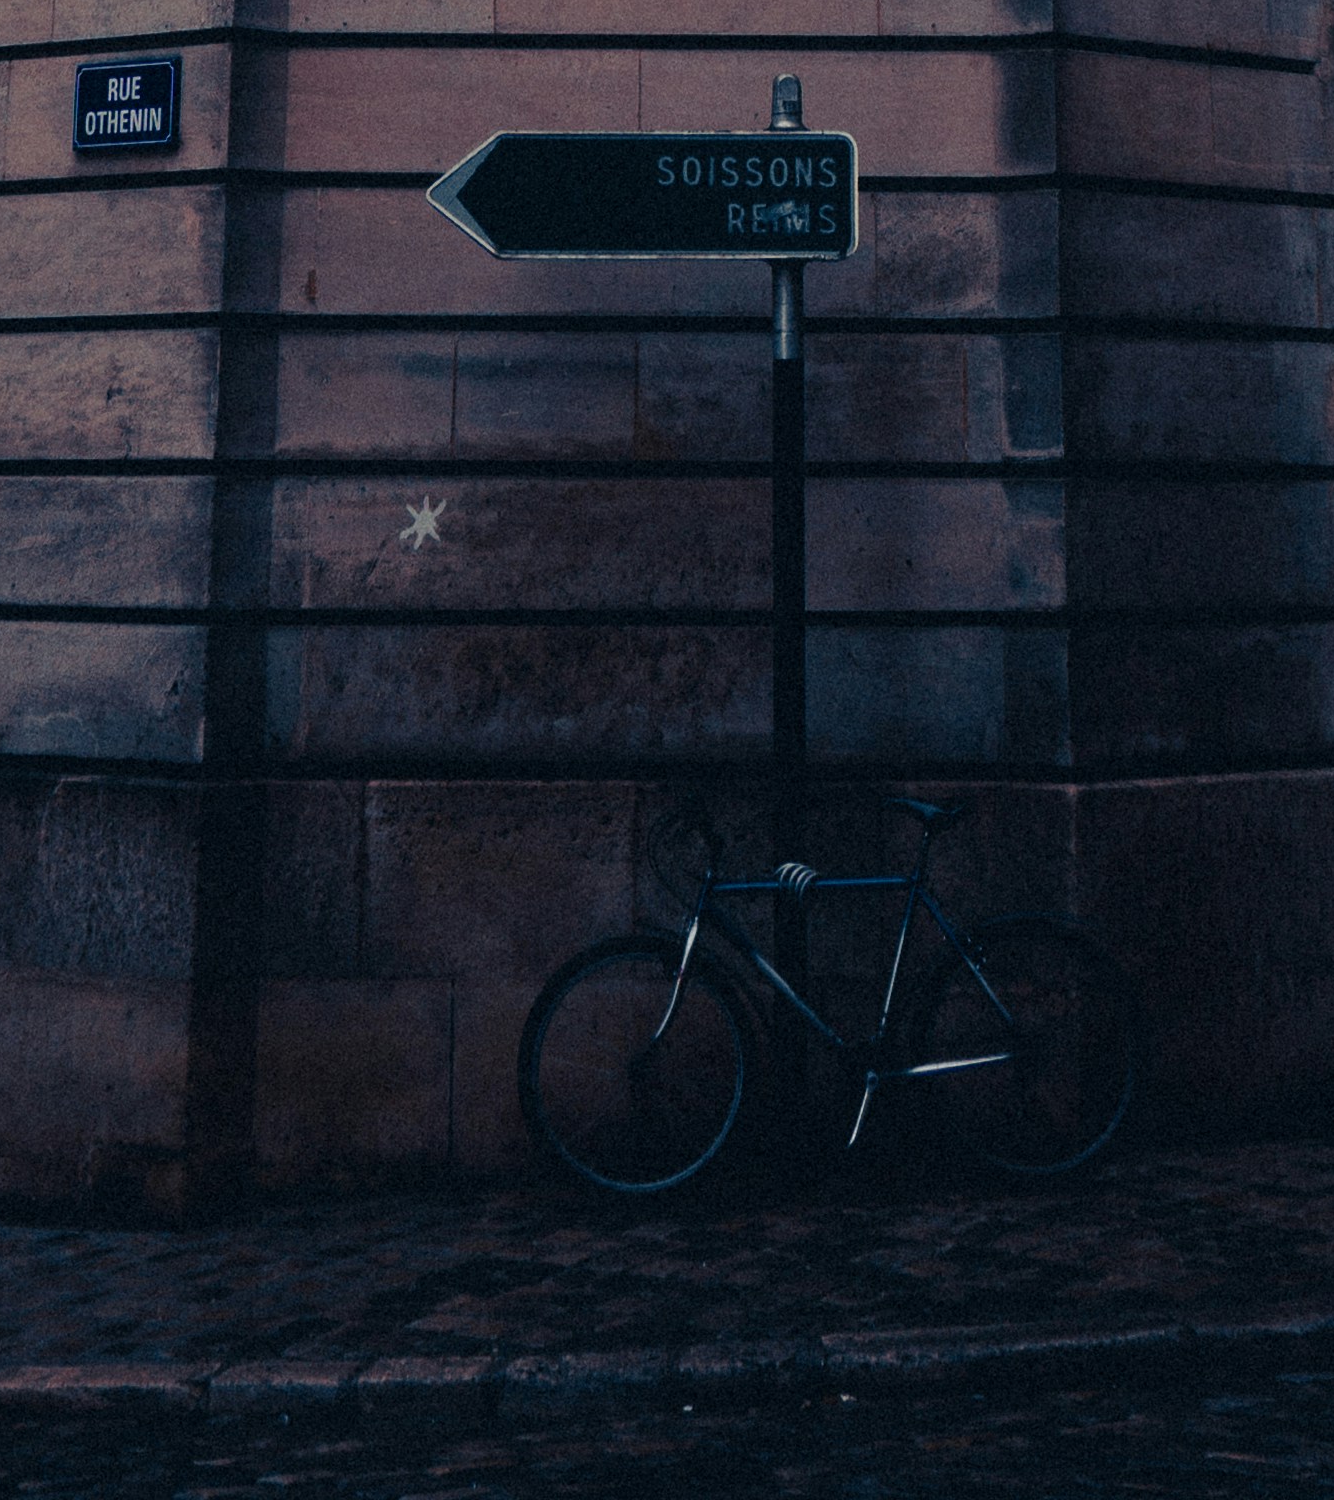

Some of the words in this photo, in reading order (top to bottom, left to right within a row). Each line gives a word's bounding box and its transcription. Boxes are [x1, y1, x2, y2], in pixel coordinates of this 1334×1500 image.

[107, 75, 142, 102] RUE
[84, 106, 163, 136] OTHENIN
[655, 155, 838, 188] SOISSONS
